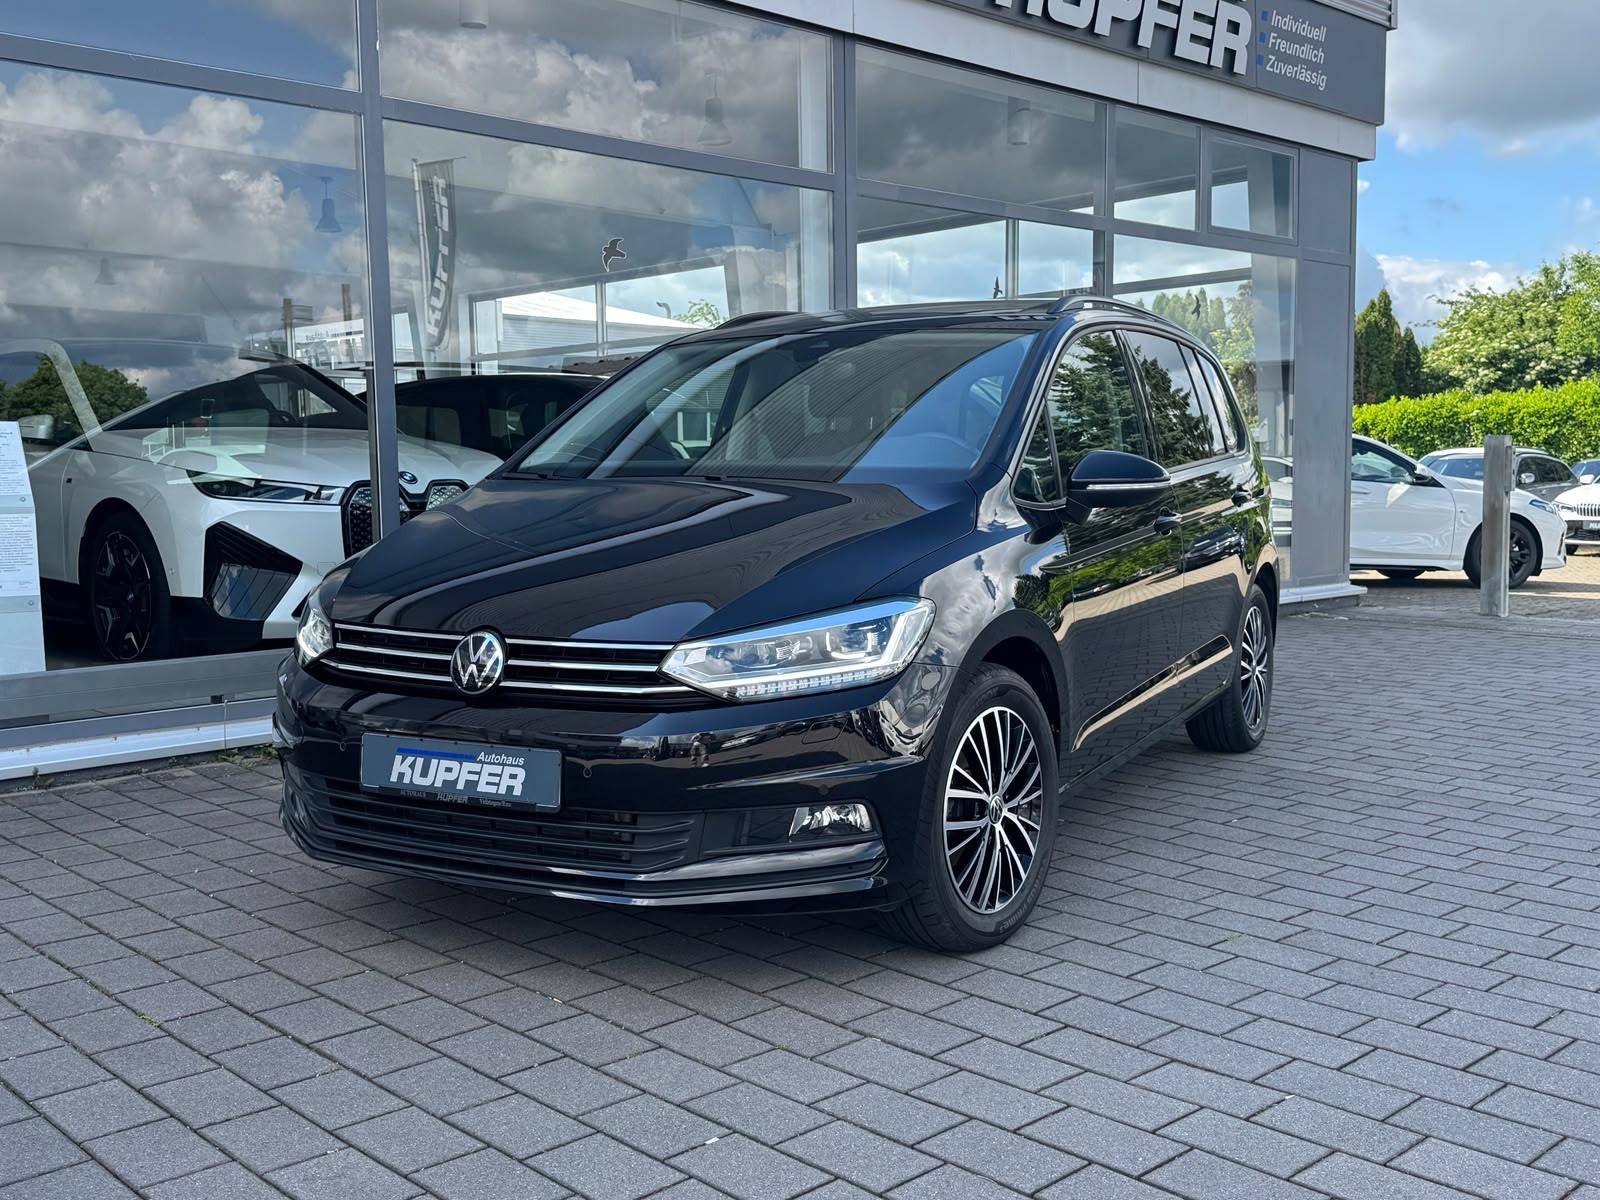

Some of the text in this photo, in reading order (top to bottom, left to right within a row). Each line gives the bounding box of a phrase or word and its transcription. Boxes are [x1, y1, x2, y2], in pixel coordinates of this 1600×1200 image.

[995, 0, 1252, 76] PFER
[1271, 9, 1327, 42] Individuell
[1268, 32, 1325, 64] Freundlich
[1265, 55, 1327, 91] Zuverlässig
[390, 755, 526, 796] KUPFER
[477, 752, 525, 766] Autohaus
